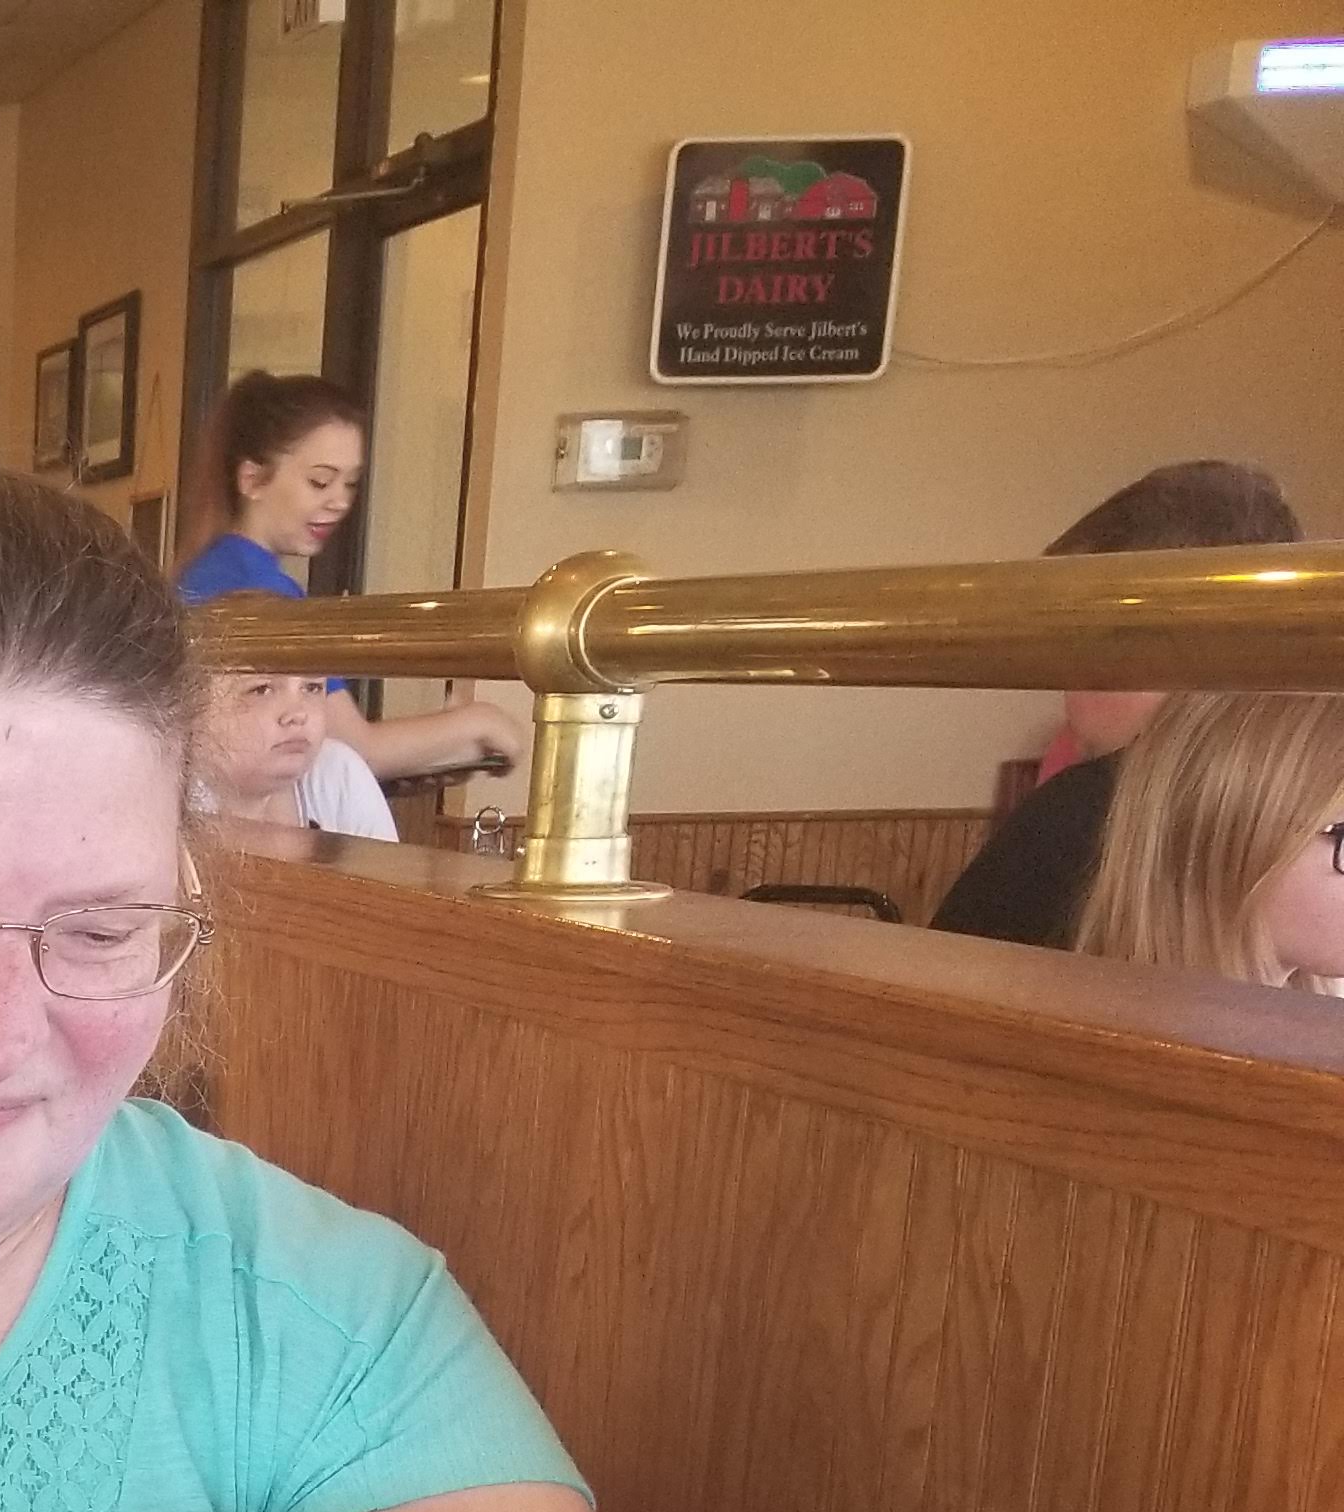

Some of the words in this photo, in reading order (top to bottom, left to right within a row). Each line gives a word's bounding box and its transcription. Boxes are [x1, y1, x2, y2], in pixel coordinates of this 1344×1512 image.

[688, 228, 874, 272] JILBERT'S
[717, 273, 836, 305] DAIRY
[676, 322, 700, 340] We
[703, 322, 761, 342] Proudly
[765, 320, 806, 338] Serve
[808, 320, 868, 341] Jilbert's
[679, 346, 721, 364] Hand
[724, 346, 779, 366] Dipped
[782, 345, 805, 362] Ice
[809, 345, 860, 361] Cream
